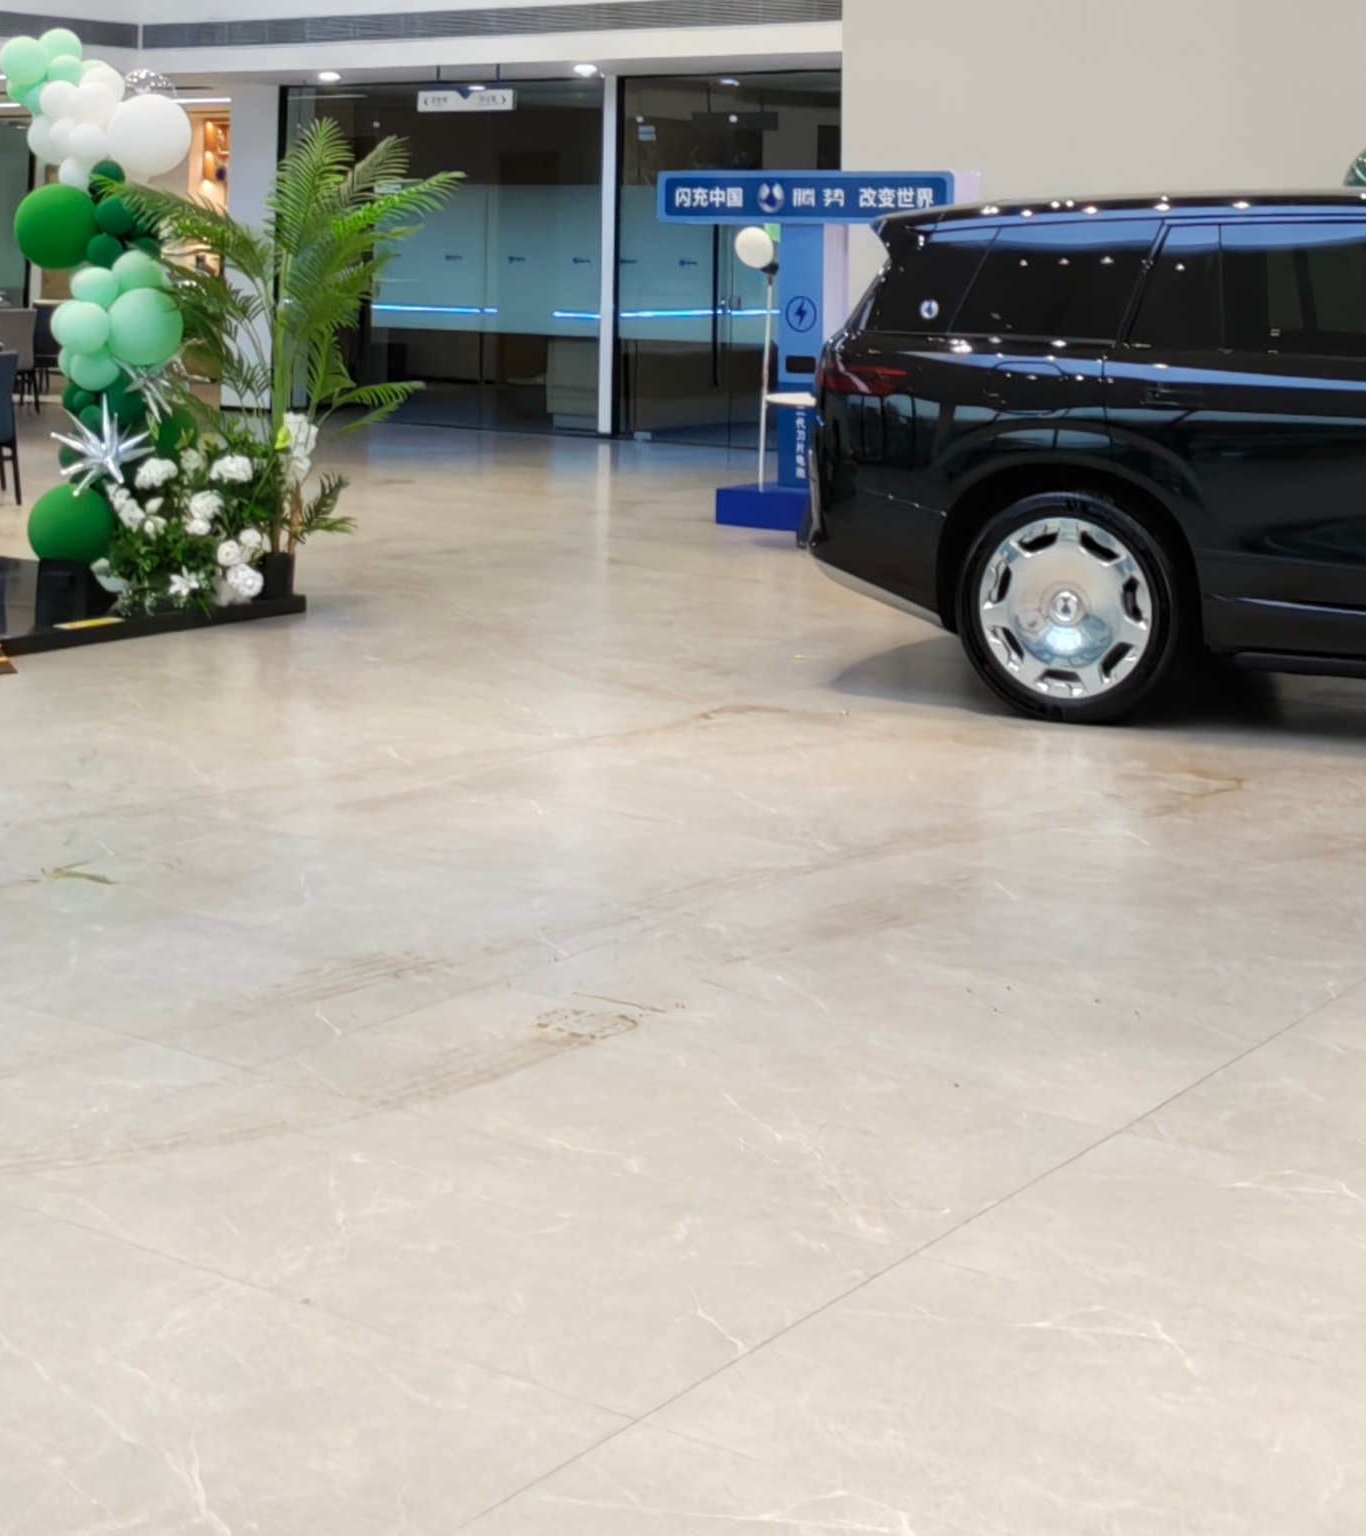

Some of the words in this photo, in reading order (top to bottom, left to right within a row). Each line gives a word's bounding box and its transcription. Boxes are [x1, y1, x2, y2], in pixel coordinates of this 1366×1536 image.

[675, 186, 743, 208] 闪充中国
[792, 187, 845, 208] 腾势
[858, 187, 935, 209] 改变世界
